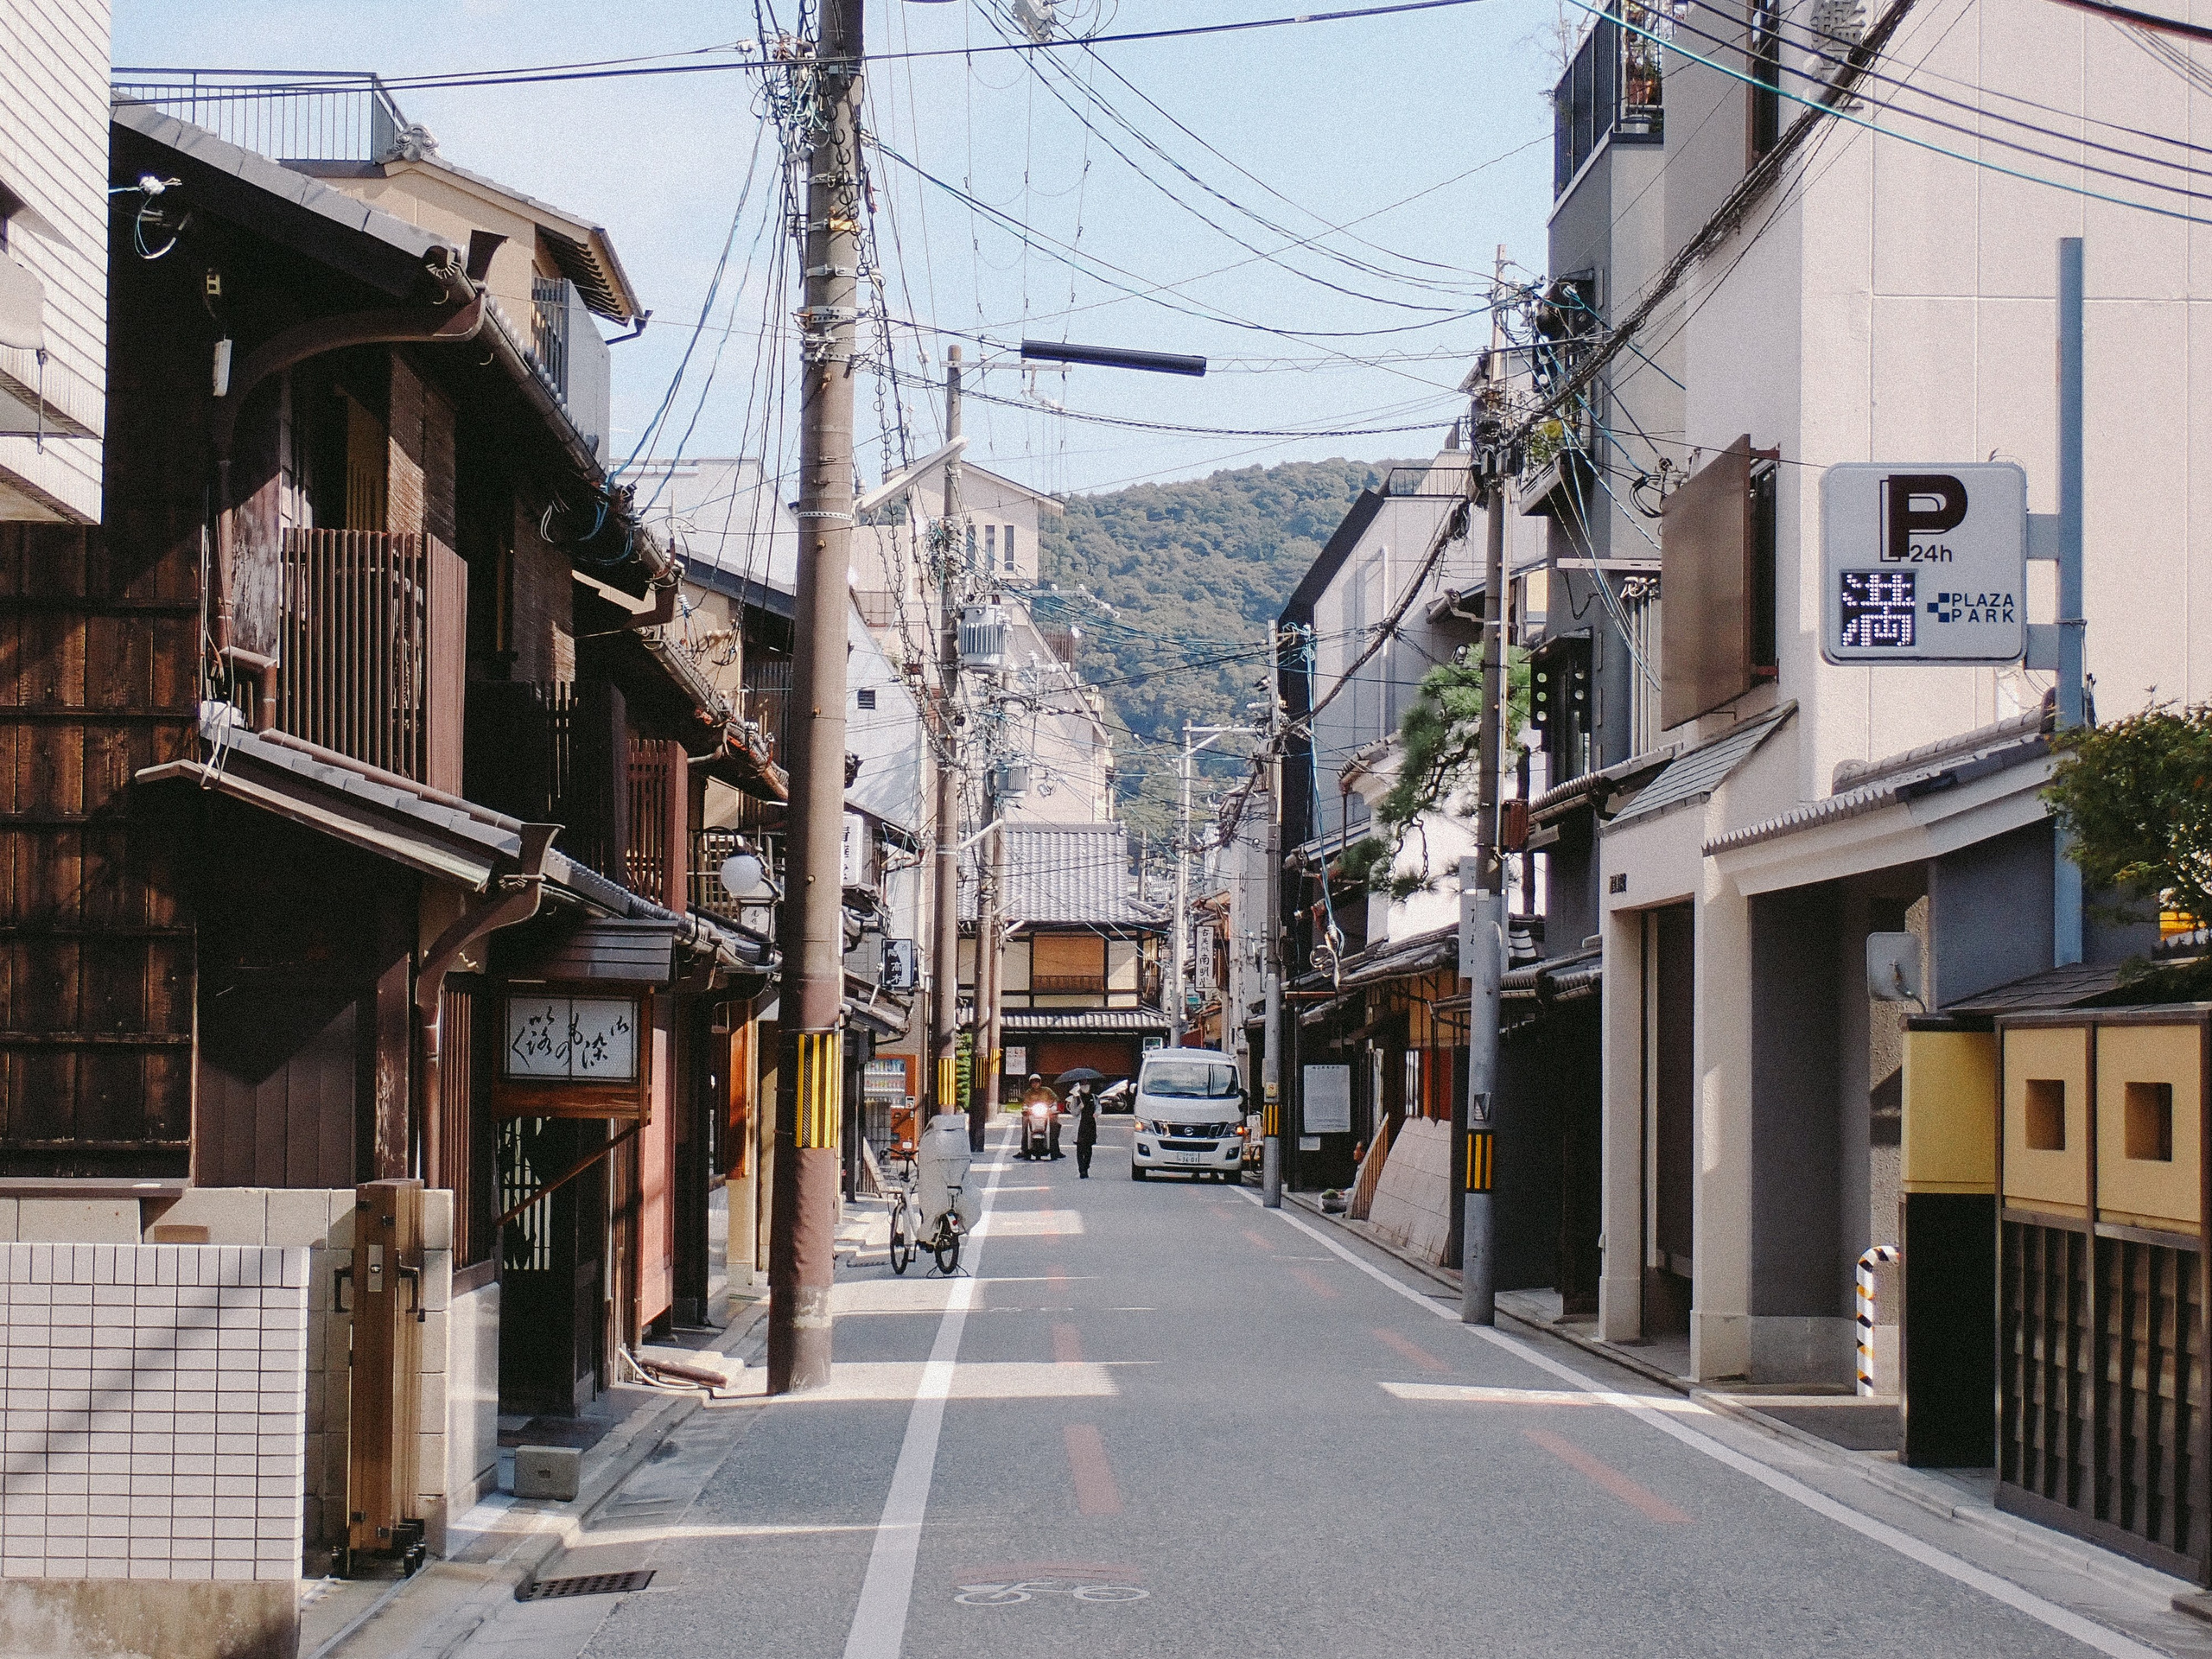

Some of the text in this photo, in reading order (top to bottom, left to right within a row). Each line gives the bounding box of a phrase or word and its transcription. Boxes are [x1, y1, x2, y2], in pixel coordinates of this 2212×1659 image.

[1880, 474, 1968, 563] P
[1910, 544, 1953, 563] 24h
[1842, 573, 1916, 646] 満
[1952, 593, 2015, 607] PLAZA
[1952, 609, 2015, 623] PARK
